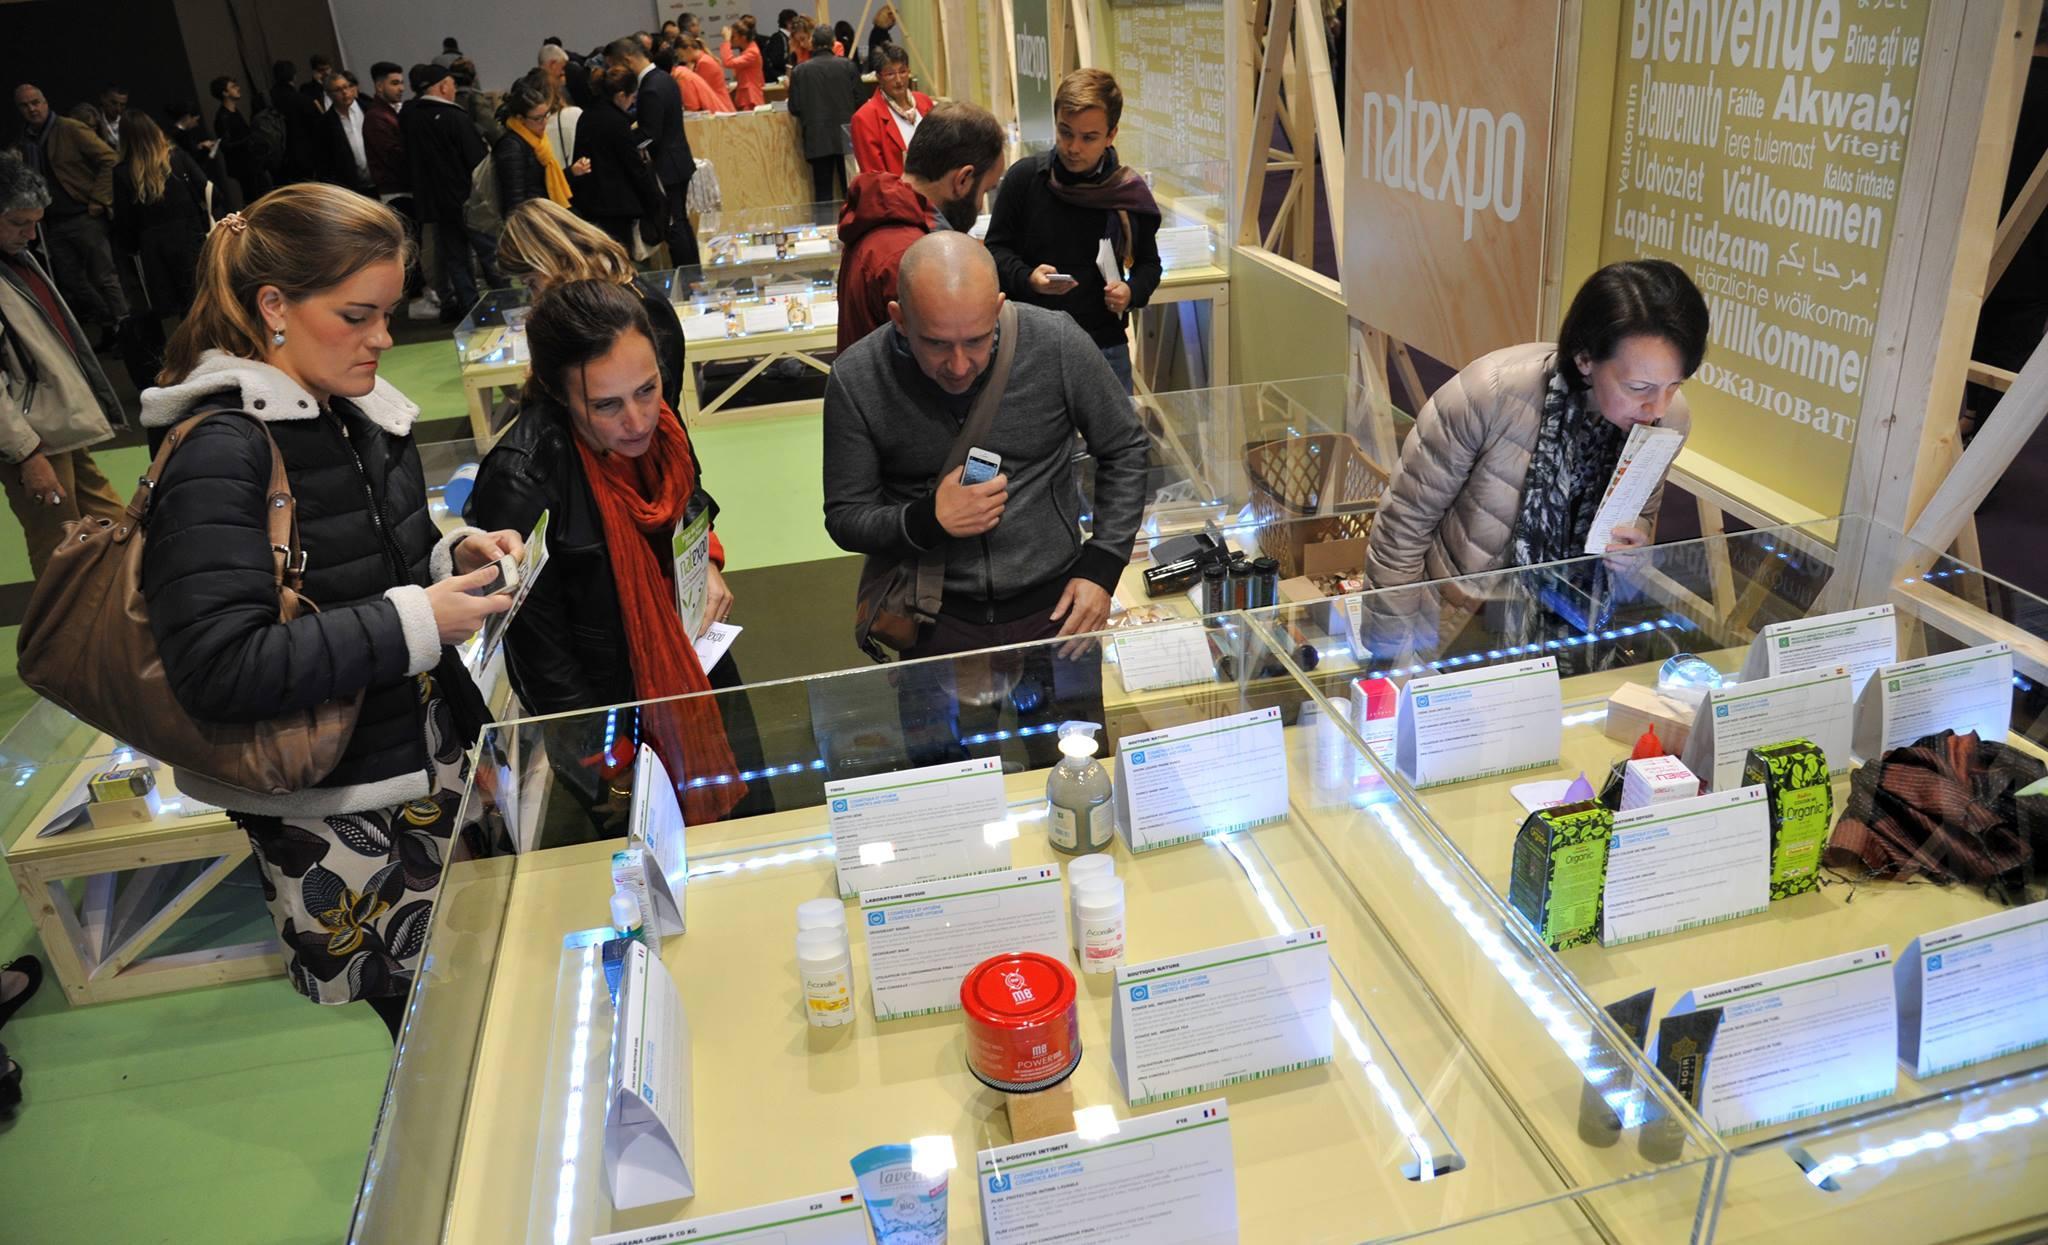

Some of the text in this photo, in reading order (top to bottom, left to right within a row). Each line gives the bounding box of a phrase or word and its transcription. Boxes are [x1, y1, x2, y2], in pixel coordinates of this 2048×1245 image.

[1016, 21, 1048, 92] natexpo
[1630, 0, 1841, 74] Bienvenue
[1844, 24, 1877, 65] Bine
[1638, 64, 1723, 148] Benvenuto
[1727, 87, 1765, 118] Fáilte
[1362, 66, 1526, 242] natexpo
[1618, 84, 1638, 193] Velkomin
[1723, 125, 1817, 170] Tere tulemast
[1634, 140, 1705, 203] Üdvözlet
[1823, 162, 1896, 200] Kalos irthate
[1614, 198, 1676, 254] Lapini
[1722, 165, 1882, 249] Välkommen
[1695, 263, 1768, 306] Härzliche
[1703, 293, 1867, 396] Willkomme
[1692, 362, 1857, 443] ожаловат
[1787, 803, 1824, 821] Organic
[1566, 852, 1593, 865] Organic
[1157, 963, 1179, 971] NATURE
